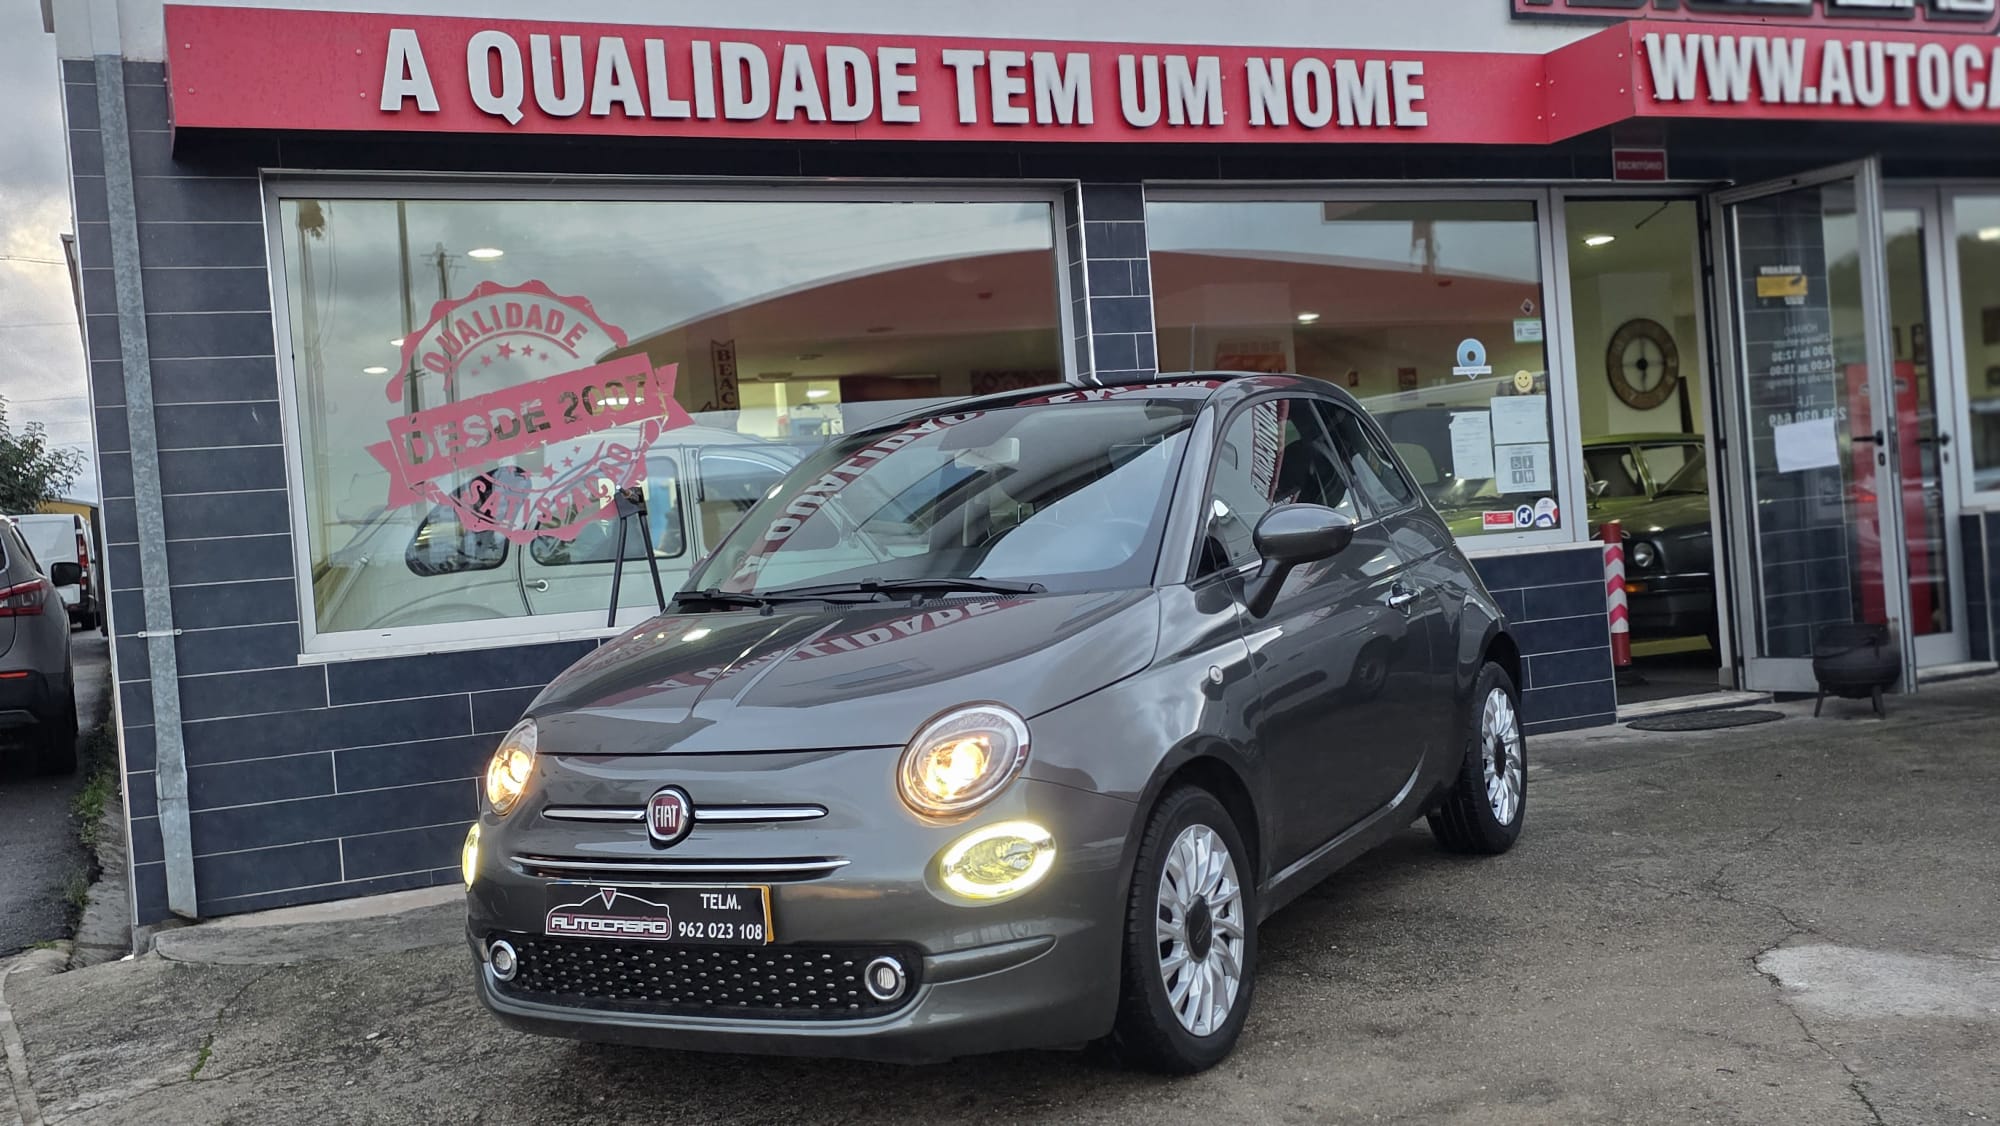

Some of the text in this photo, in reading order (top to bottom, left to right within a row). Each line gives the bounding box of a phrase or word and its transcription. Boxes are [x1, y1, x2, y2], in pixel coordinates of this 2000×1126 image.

[380, 28, 1428, 128] A QUALIDADE TEM UM NOME
[422, 302, 588, 374] QUALIDADE
[717, 349, 736, 410] BEAC
[404, 373, 648, 466] DESDE 2007
[655, 804, 679, 828] FIAT
[678, 921, 763, 940] 962 023 108
[700, 893, 742, 910] TELM.
